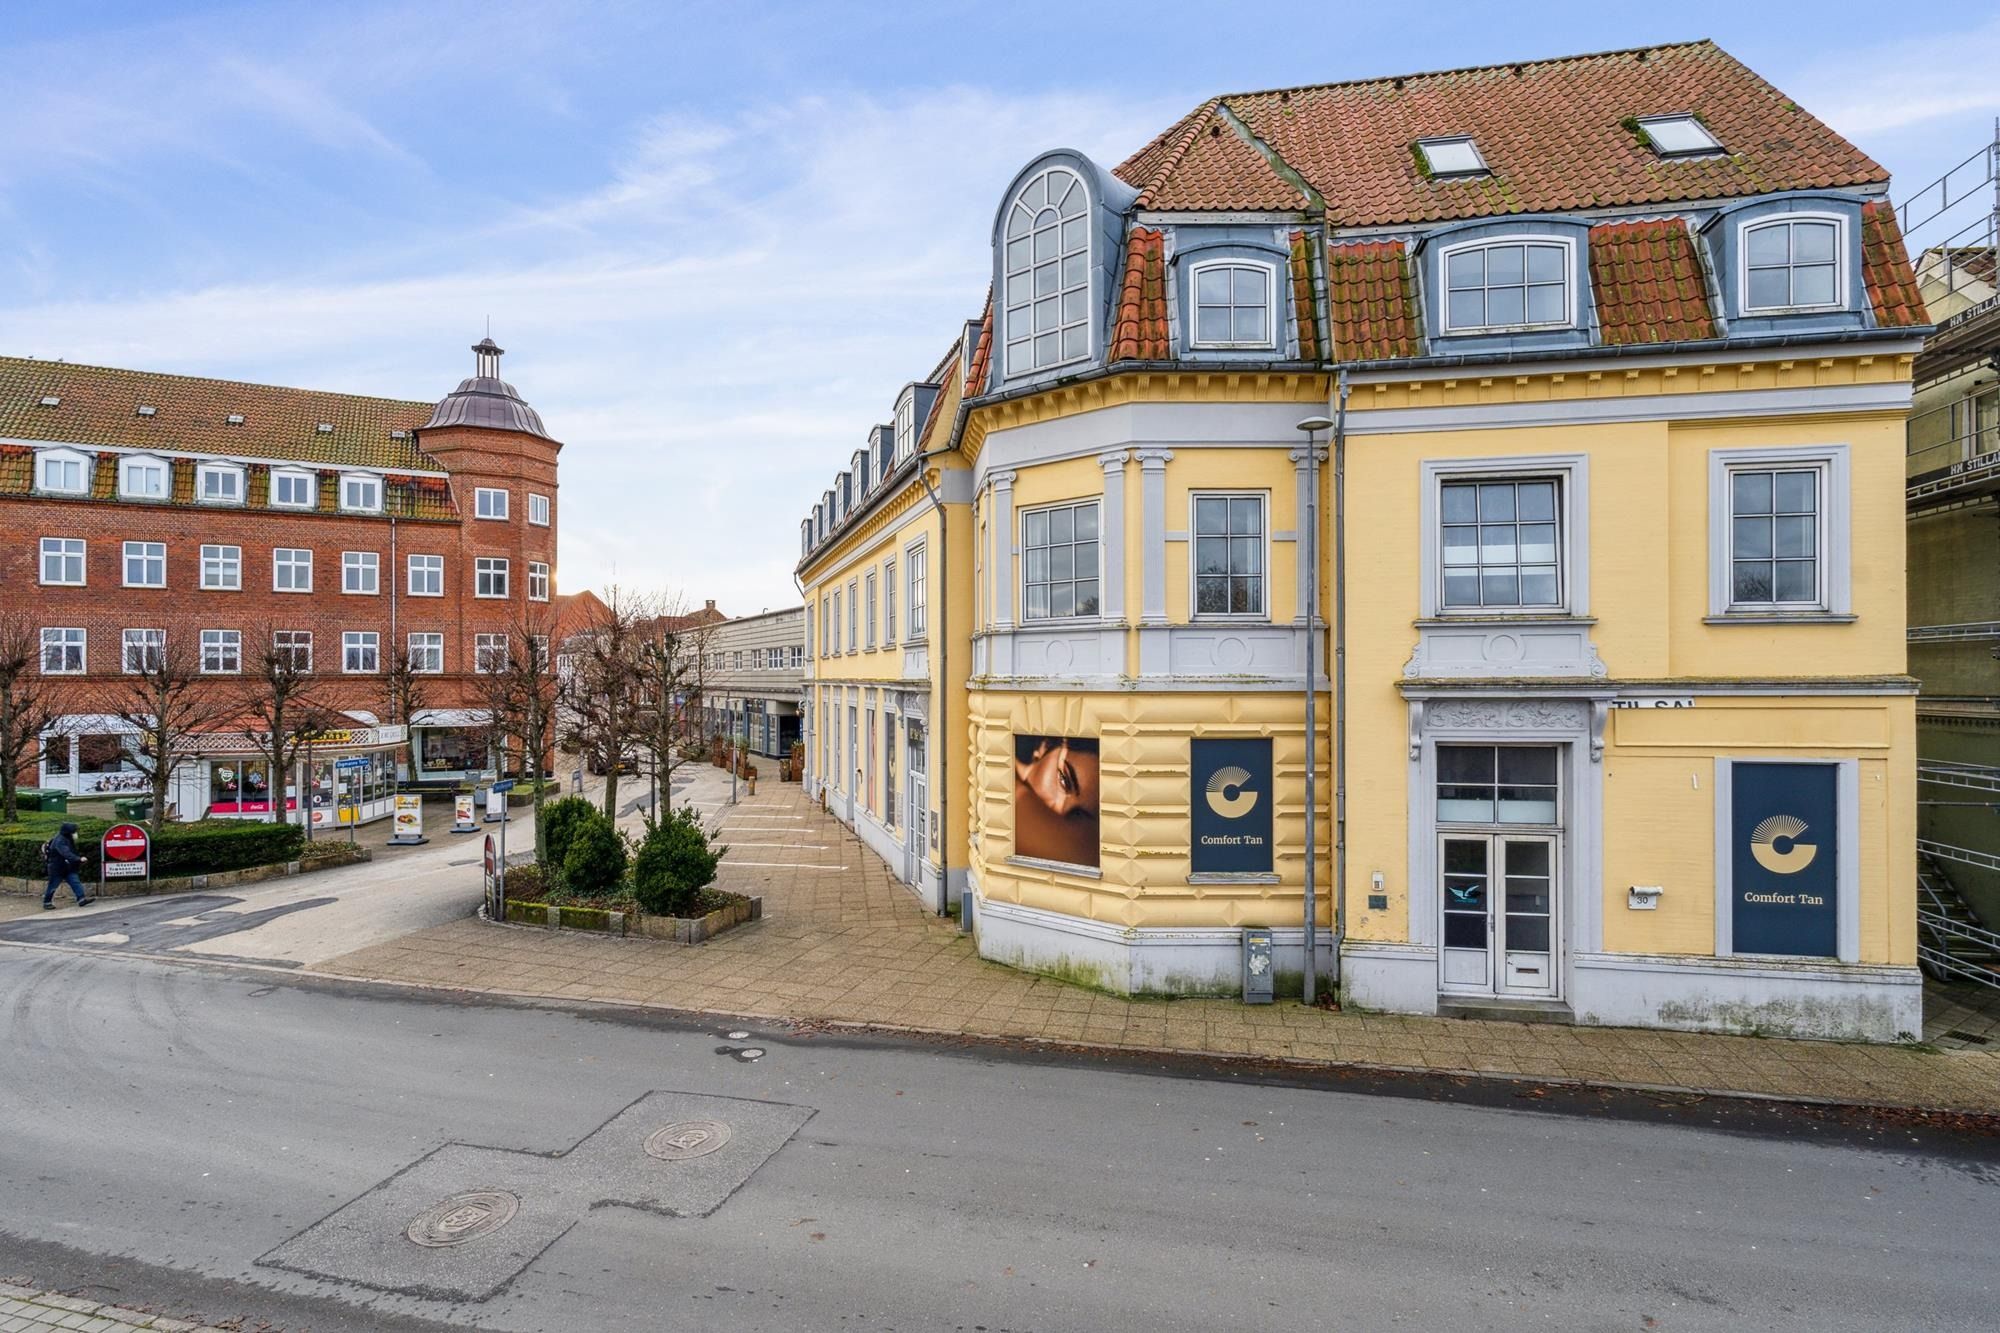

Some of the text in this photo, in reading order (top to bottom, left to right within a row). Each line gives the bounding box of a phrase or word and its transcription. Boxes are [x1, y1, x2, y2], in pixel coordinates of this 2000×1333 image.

[1201, 835, 1263, 845] Comfort Tan
[1637, 896, 1648, 904] 30
[1744, 892, 1824, 905] Comfort Tan
